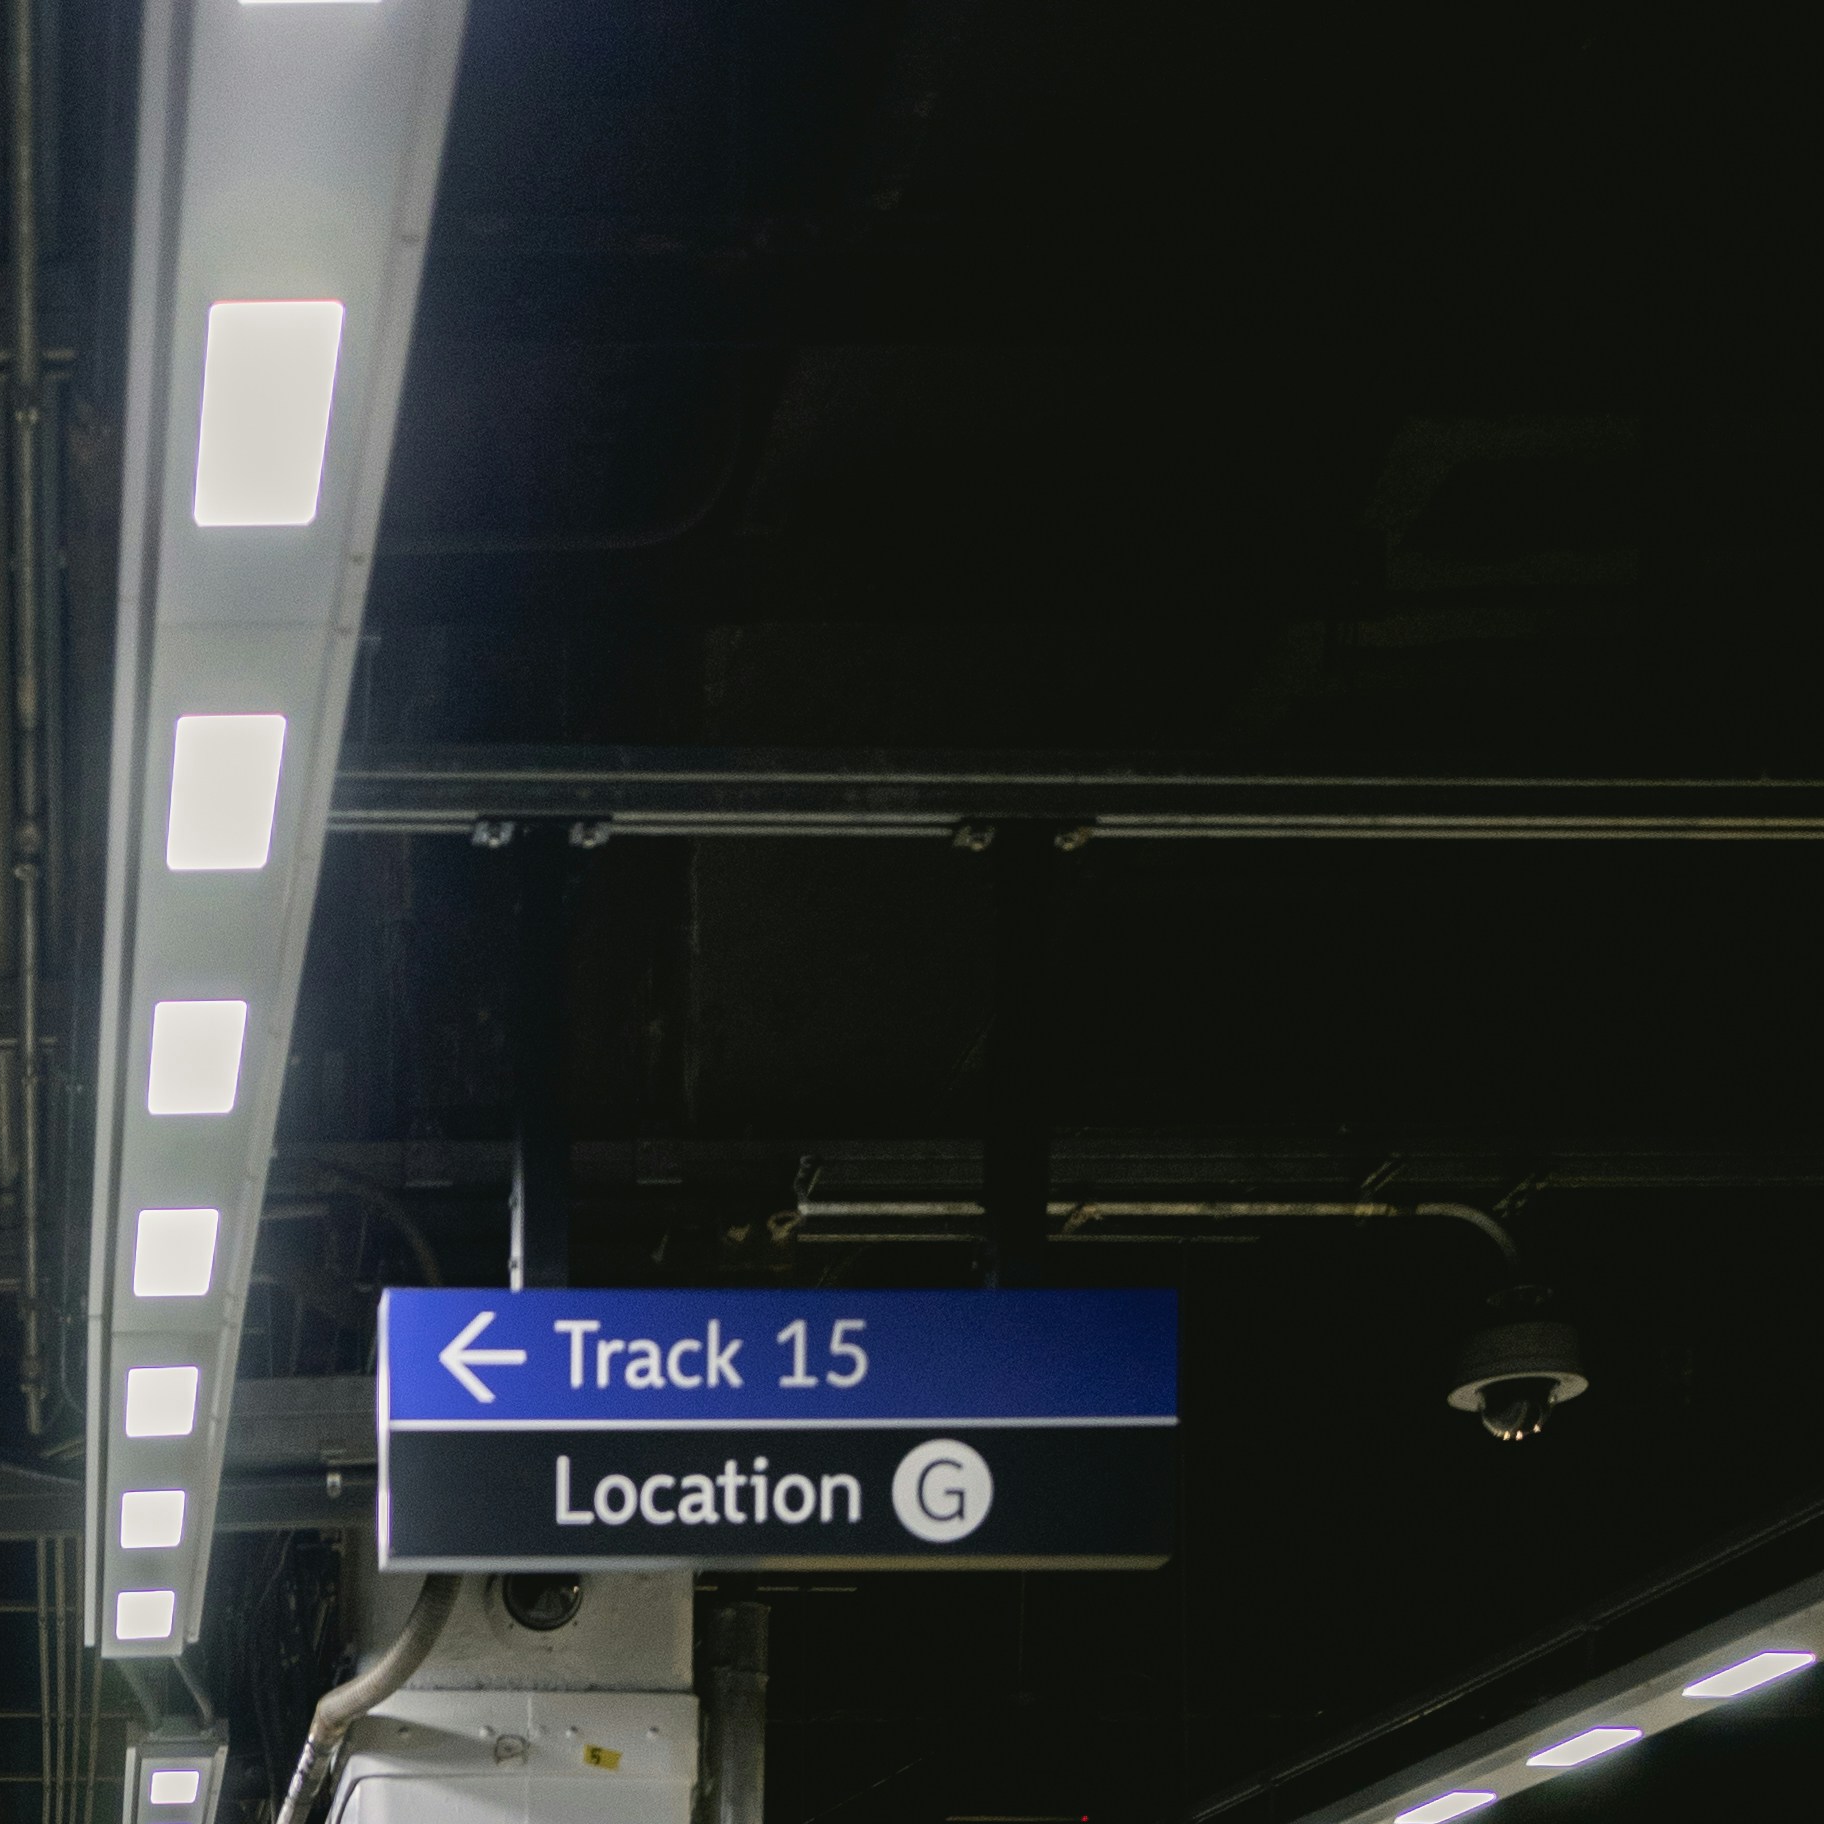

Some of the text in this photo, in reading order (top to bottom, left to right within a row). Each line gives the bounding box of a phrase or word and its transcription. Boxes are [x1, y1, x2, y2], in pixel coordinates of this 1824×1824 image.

[555, 1319, 869, 1390] Track 15
[555, 1456, 968, 1525] Location G
